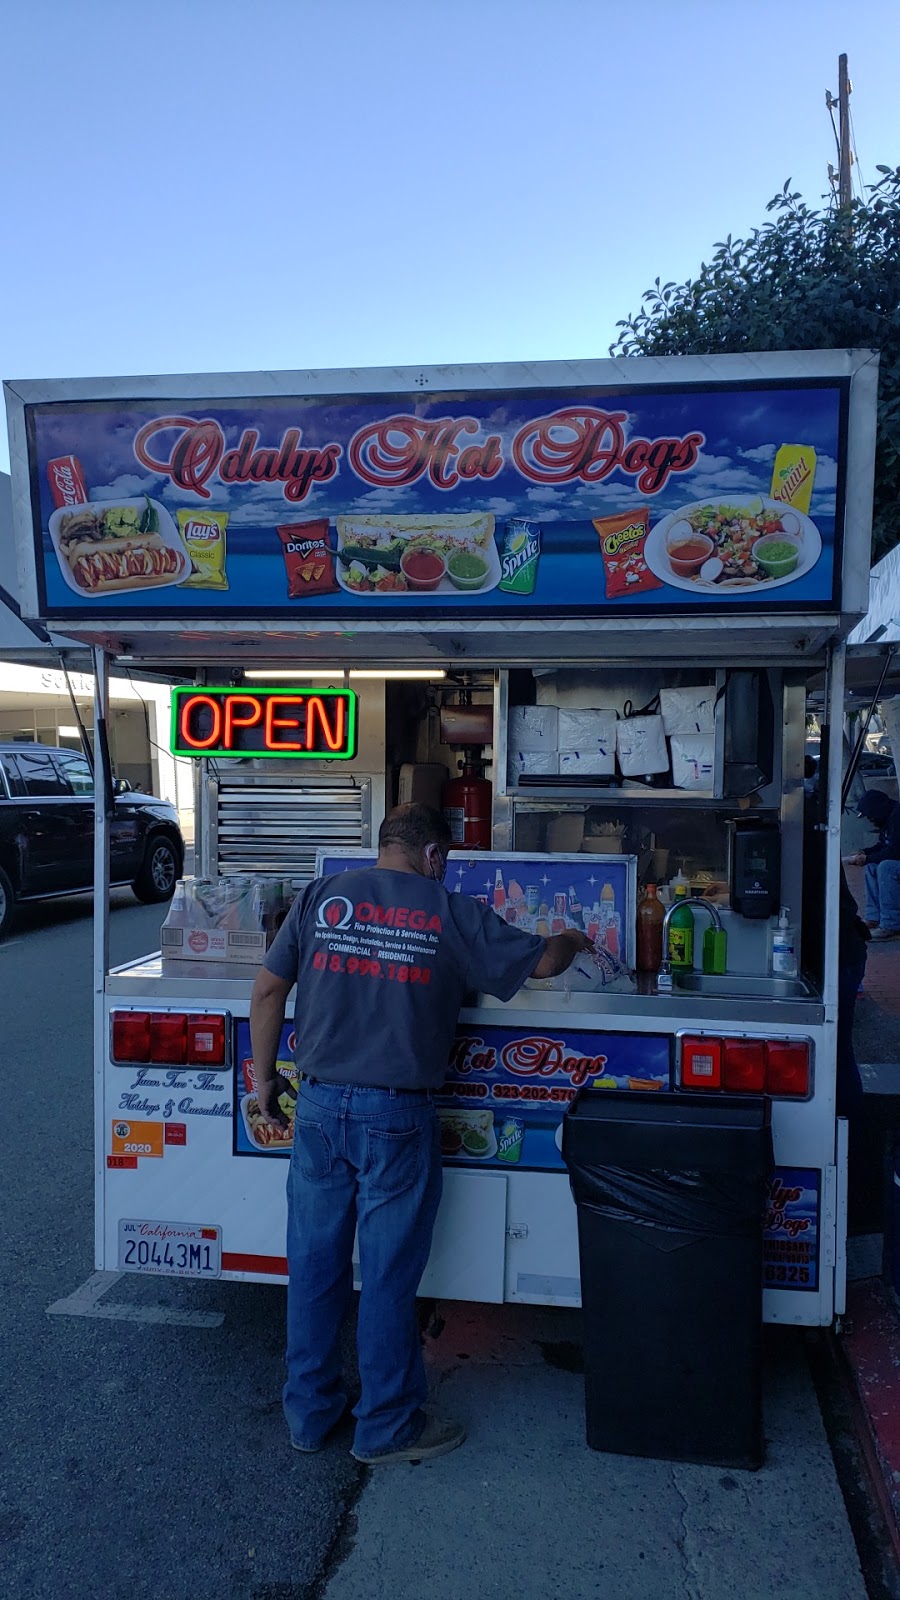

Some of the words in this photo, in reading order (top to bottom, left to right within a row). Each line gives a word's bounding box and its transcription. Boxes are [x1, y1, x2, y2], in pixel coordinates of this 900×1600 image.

[134, 416, 342, 502] Odalys
[349, 412, 503, 492] Hot
[513, 405, 706, 494] Dogs
[286, 539, 325, 553] Doritos
[604, 524, 645, 554] Cheetos
[189, 550, 215, 559] Classic
[502, 540, 538, 579] Sprite
[181, 695, 345, 751] OPEN
[355, 901, 442, 934] OMEGA
[354, 922, 366, 932] Fire
[366, 925, 395, 937] Protection
[395, 929, 401, 937] &
[401, 929, 428, 943] Services,
[428, 934, 440, 944] Inc.
[328, 942, 371, 956] COMMERCIAL
[377, 949, 415, 963] RESIDENTIAL
[500, 1036, 608, 1086] Dogs
[130, 1068, 161, 1090] Juan
[162, 1098, 176, 1118] &
[124, 1142, 152, 1153] 2020
[500, 1130, 522, 1153] Sprite
[123, 1224, 136, 1232] JUL
[139, 1223, 197, 1240] California
[124, 1239, 214, 1271] 20443M1
[143, 1266, 196, 1275] dmv.ca.gov
